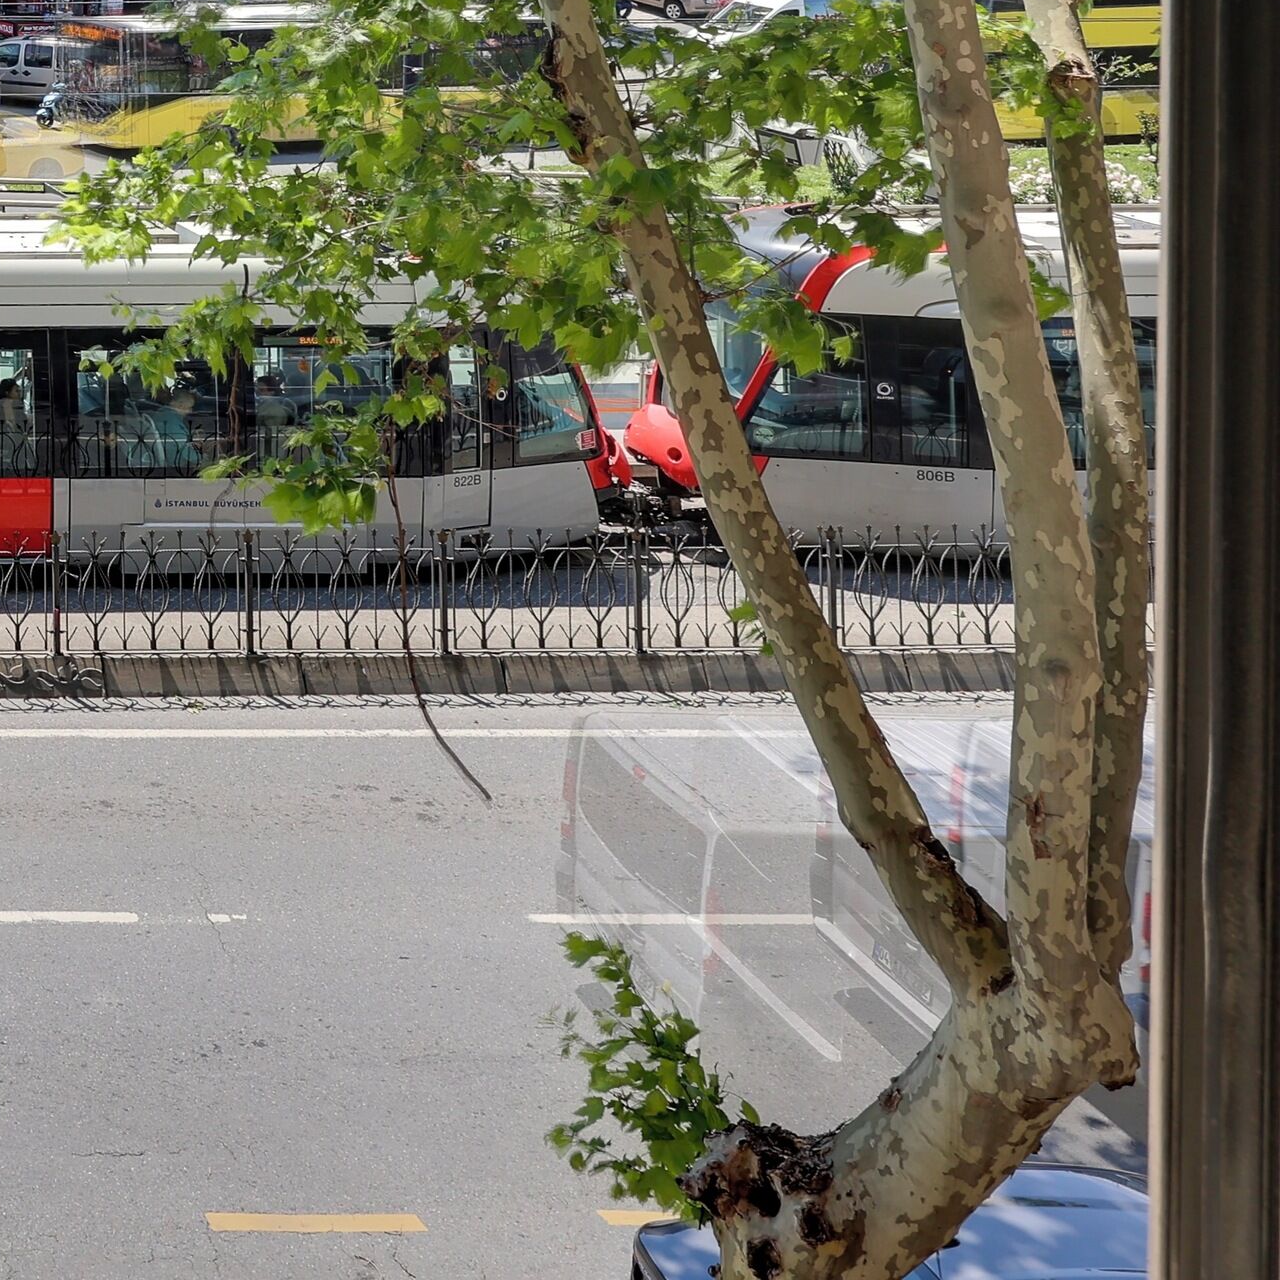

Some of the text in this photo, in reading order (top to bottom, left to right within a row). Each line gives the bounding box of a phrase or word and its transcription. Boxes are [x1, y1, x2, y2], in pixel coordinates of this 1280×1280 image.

[454, 475, 482, 488] 822B
[916, 469, 955, 482] 806B
[165, 499, 262, 509] İSTANBUL BÜYÜKŞEH
